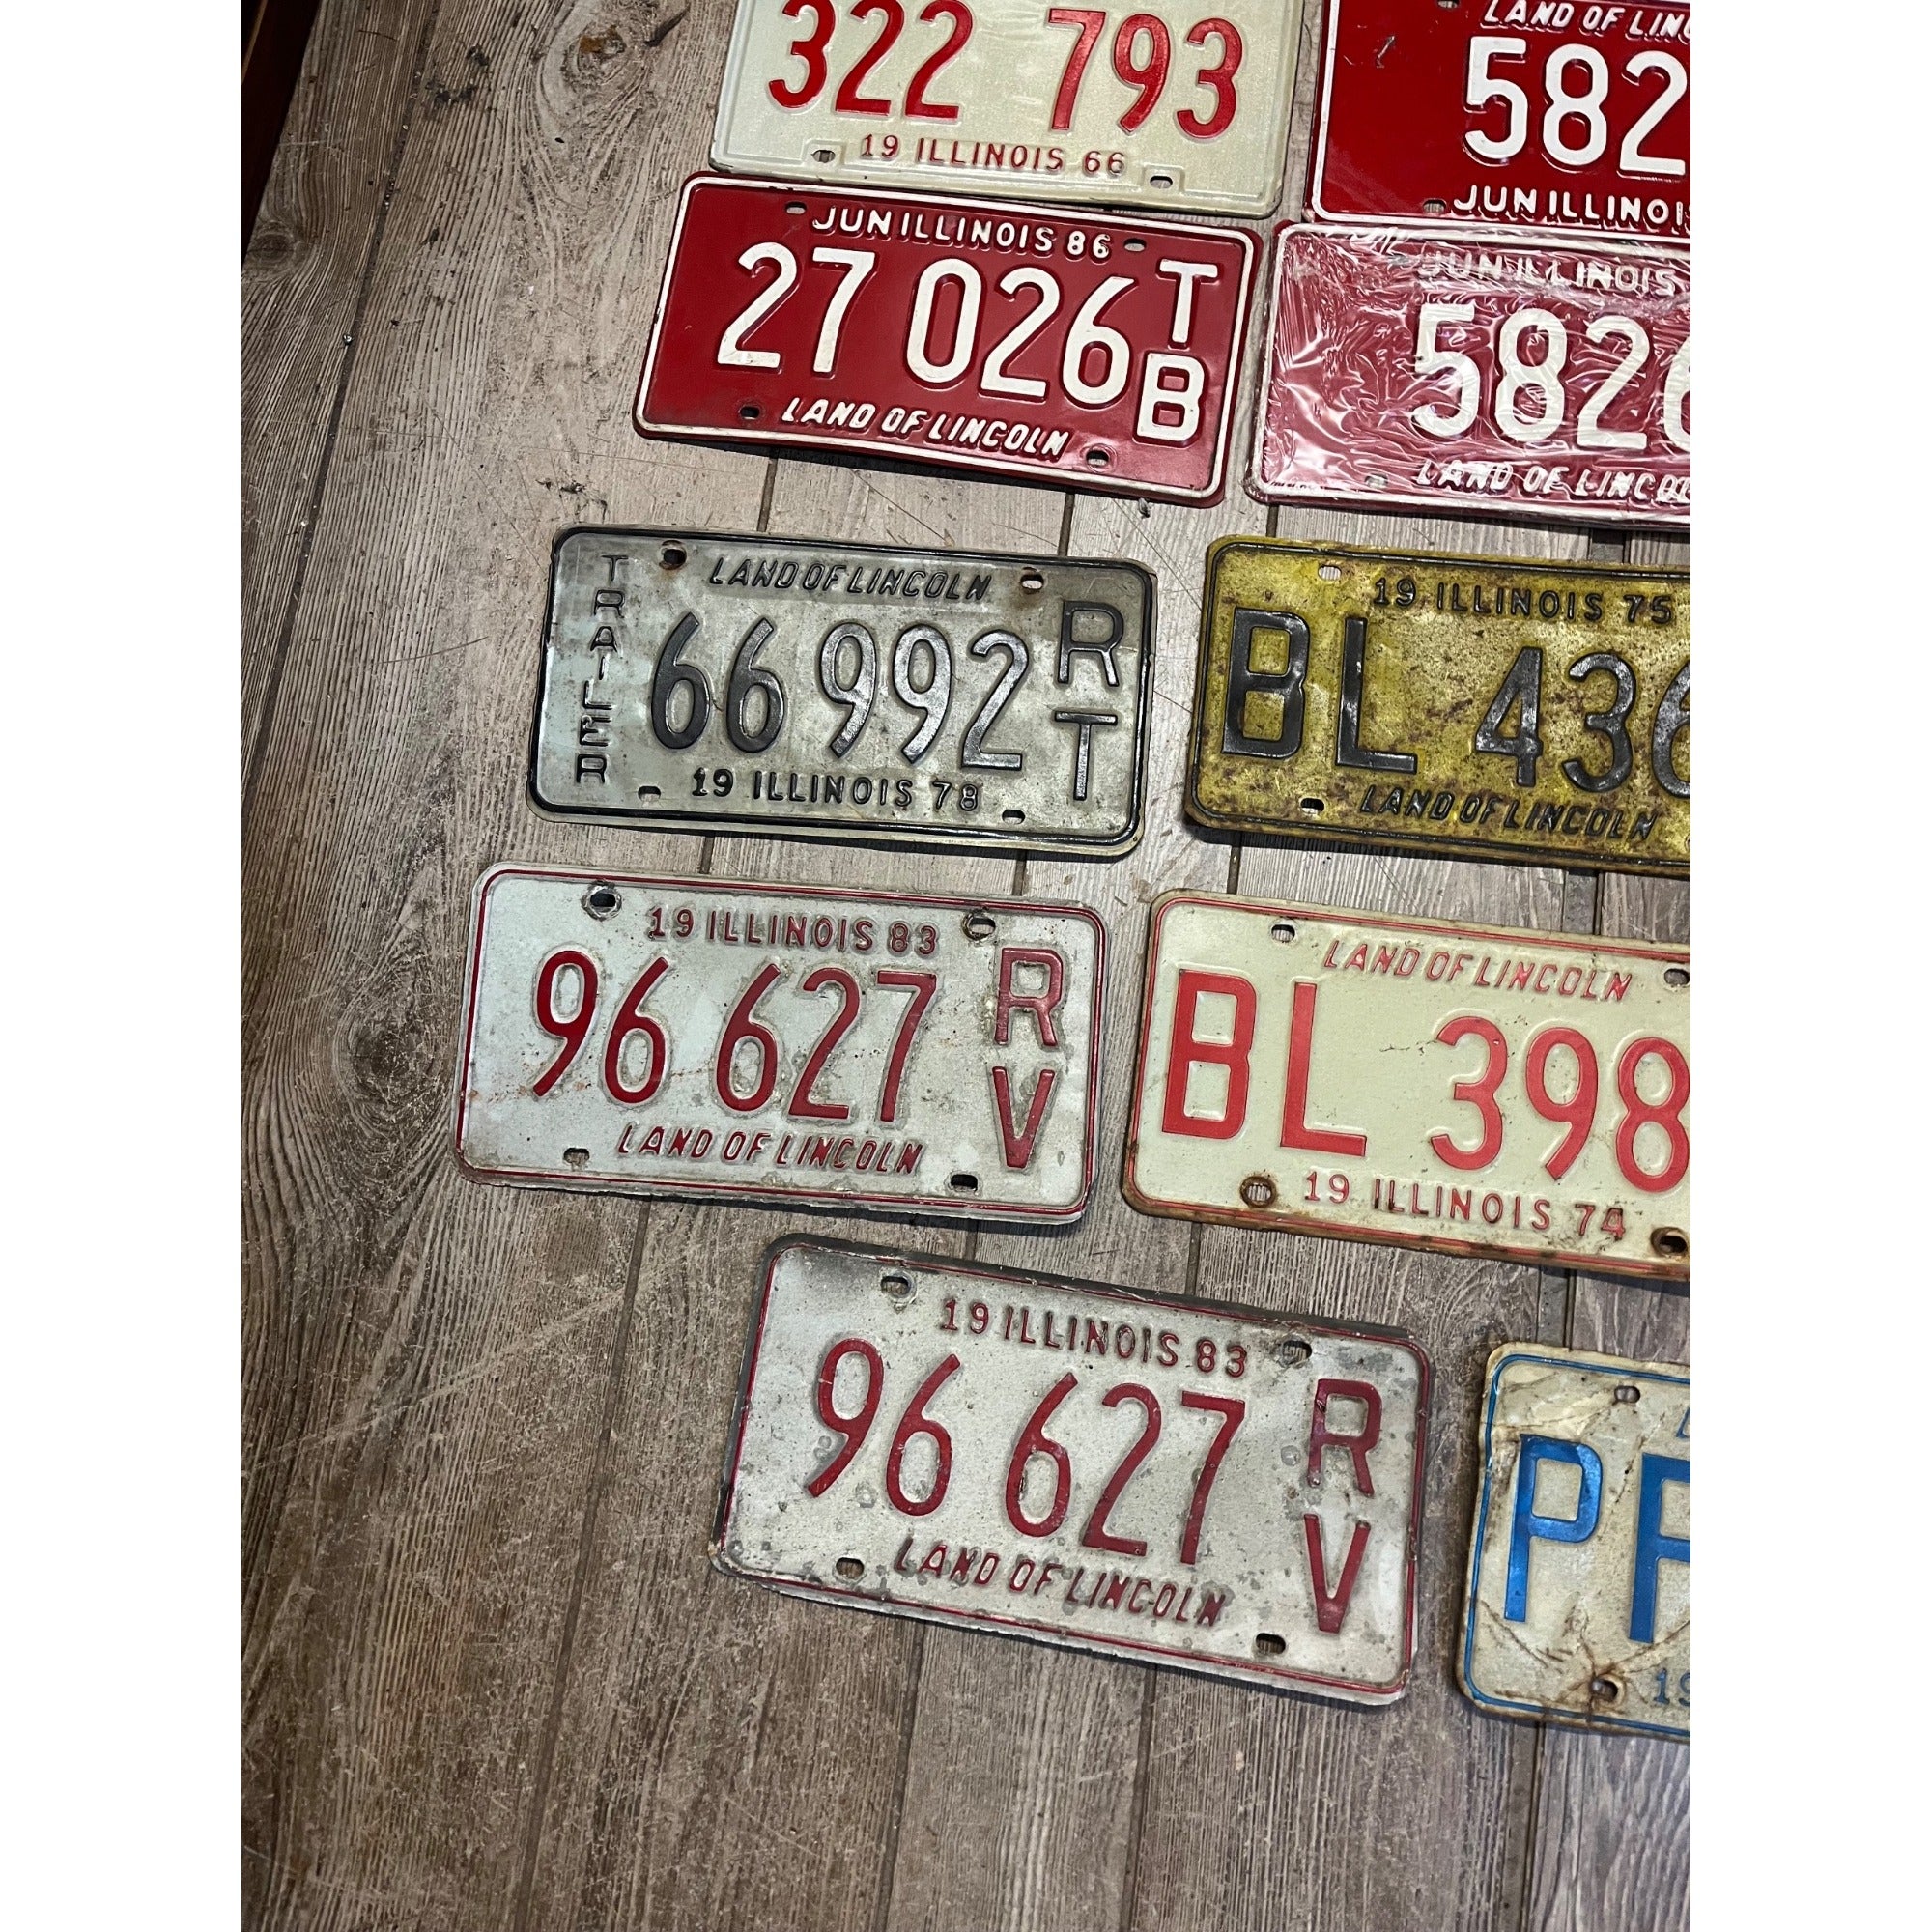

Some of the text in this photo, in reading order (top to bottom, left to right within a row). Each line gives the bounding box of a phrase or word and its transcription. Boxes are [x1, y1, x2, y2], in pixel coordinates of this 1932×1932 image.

[1484, 0, 1575, 27] LAND
[1582, 6, 1626, 31] OF
[768, 0, 1243, 138] 322 793
[1464, 36, 1687, 175] 582
[861, 133, 1126, 176] 19 ILLINOIS 66
[810, 205, 1113, 259] JUN ILLINOIS 86
[1453, 185, 1690, 228] JUN ILLINOI
[1418, 249, 1677, 296] JUN ILLINOIS
[717, 242, 1135, 404] 27 026
[782, 397, 1069, 456] LAND OF LINCOLN
[1416, 460, 1512, 492] LAND
[1523, 467, 1567, 495] OF
[709, 557, 992, 600] LAND OF LINCOLN
[1373, 577, 1673, 624] 19 ILLINOIS 75
[577, 555, 629, 785] TRAILER
[651, 611, 1029, 771] 66 992
[1221, 607, 1417, 774] BL
[691, 768, 980, 811] 19 ILLINOIS 78
[1360, 784, 1659, 840] LAND OF LINCOLN
[647, 907, 938, 953] 19 ILLINOIS 83
[1323, 940, 1632, 1002] LAND OF LINCOLN
[531, 950, 937, 1122] 96 627
[1161, 970, 1690, 1192] BL 398
[617, 1123, 925, 1174] LAND OF LINCOLN
[1305, 1171, 1627, 1240] 19 ILLINOIS 74
[940, 1298, 1248, 1378] 19 ILLINOIS 83
[807, 1338, 1246, 1565] 96 627
[895, 1538, 1228, 1628] LAND OF LINCOLN
